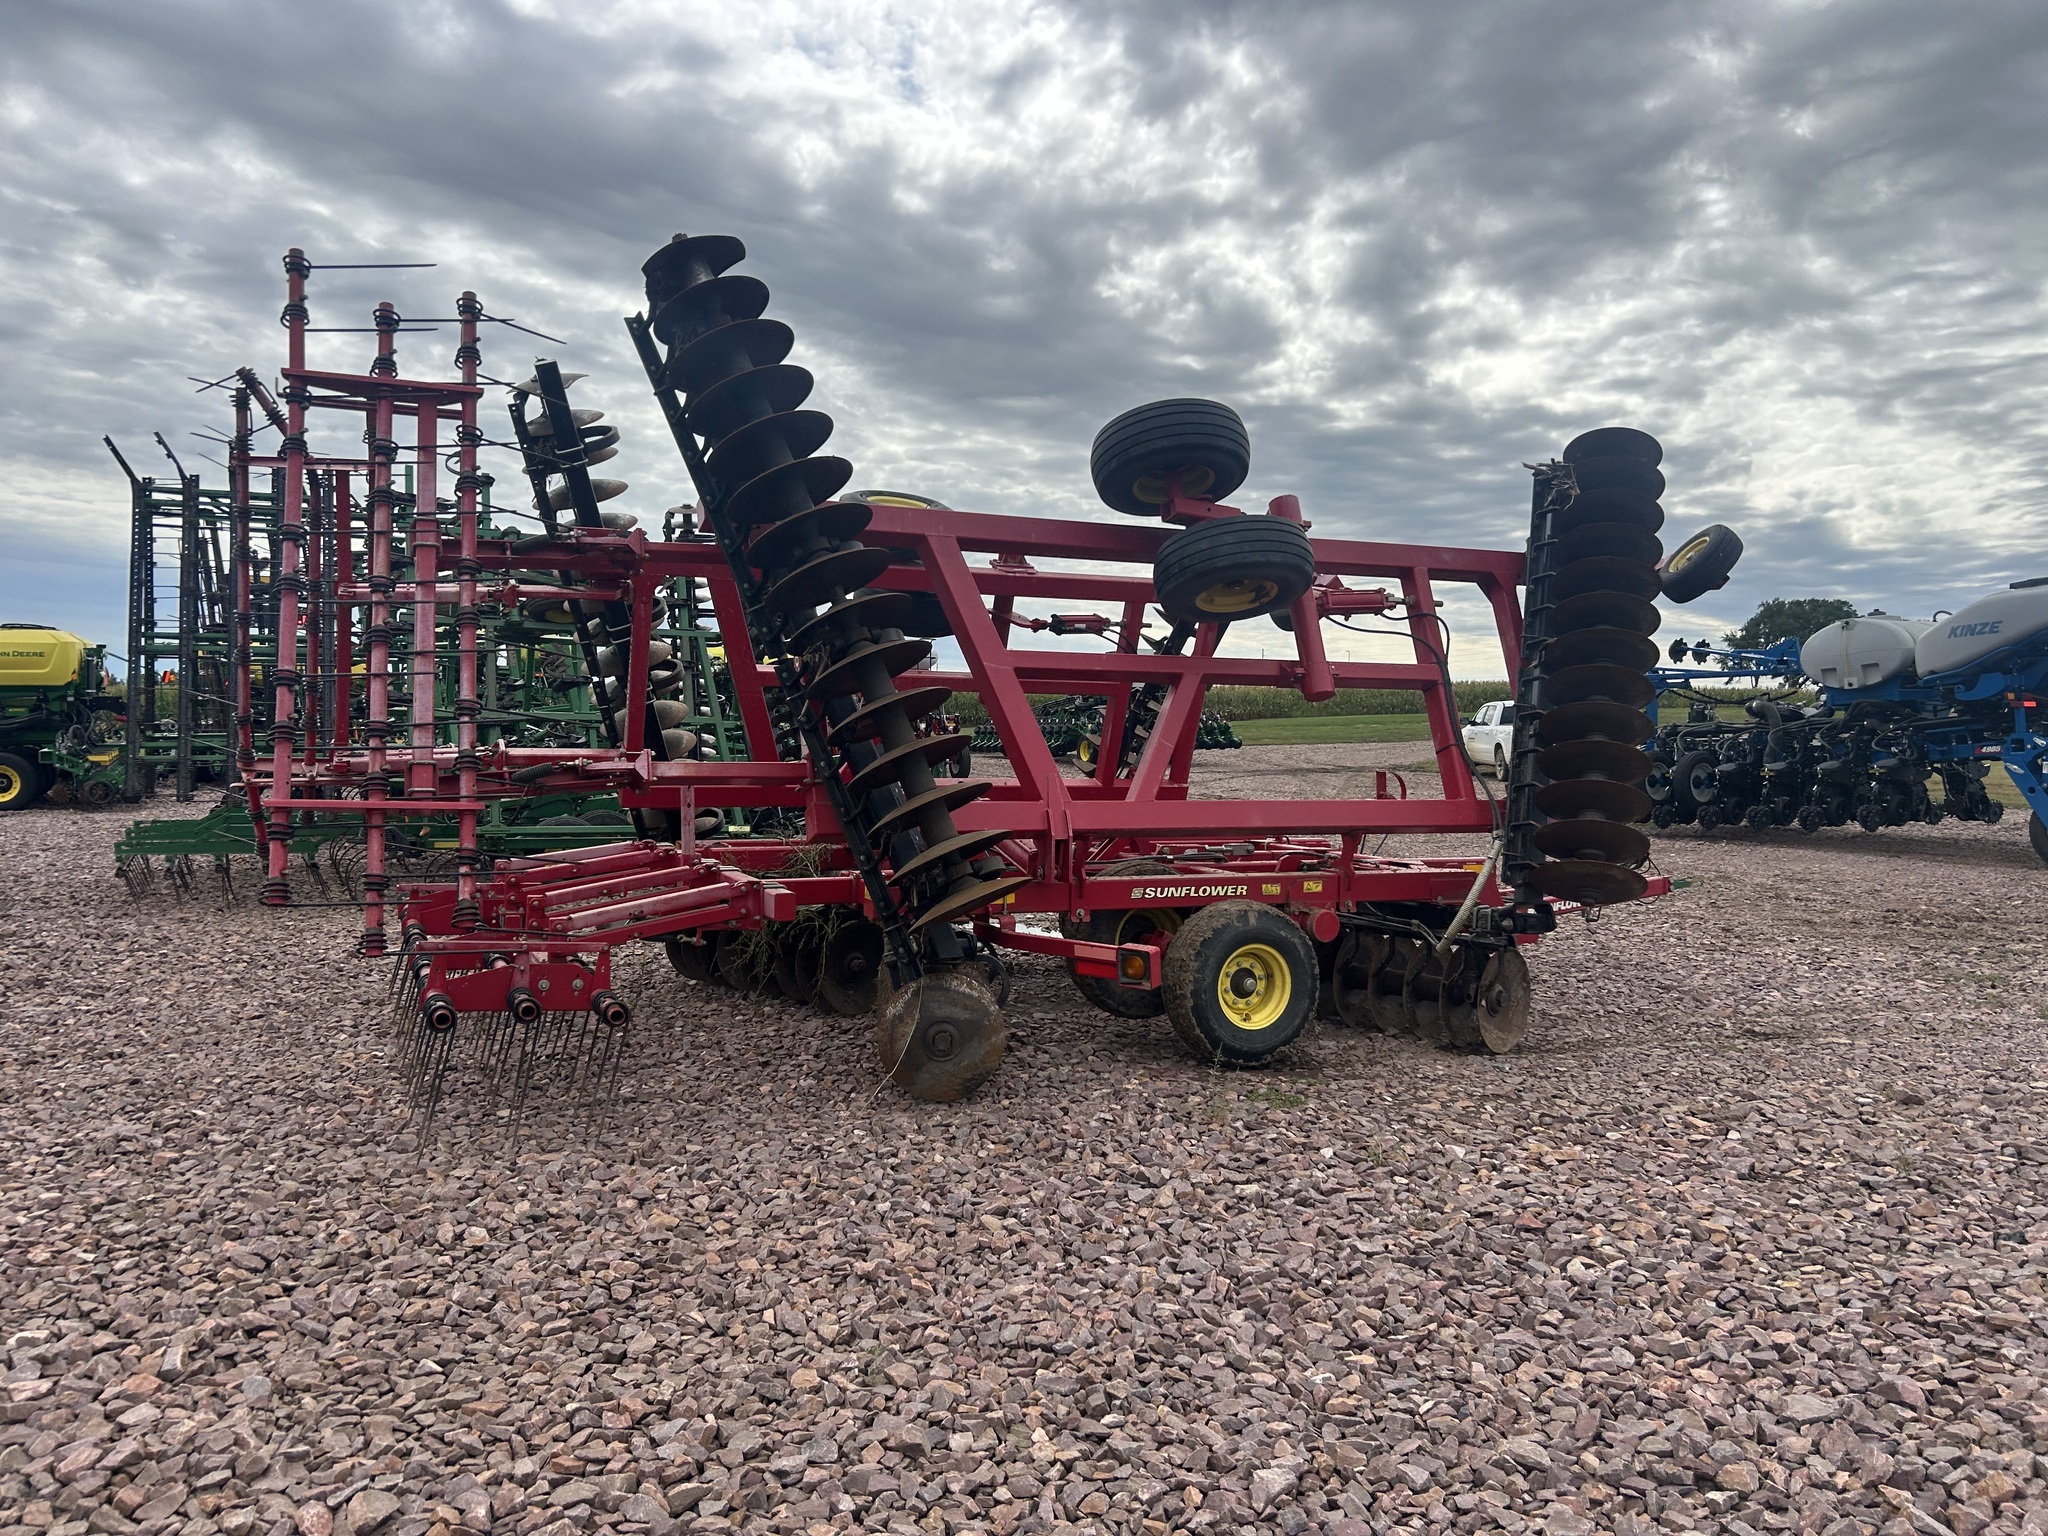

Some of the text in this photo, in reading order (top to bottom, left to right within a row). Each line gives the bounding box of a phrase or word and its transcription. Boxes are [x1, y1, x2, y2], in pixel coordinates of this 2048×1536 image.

[1947, 620, 2003, 639] KINZE
[12, 650, 45, 658] DEERE
[1144, 885, 1248, 899] SUNFLOWER
